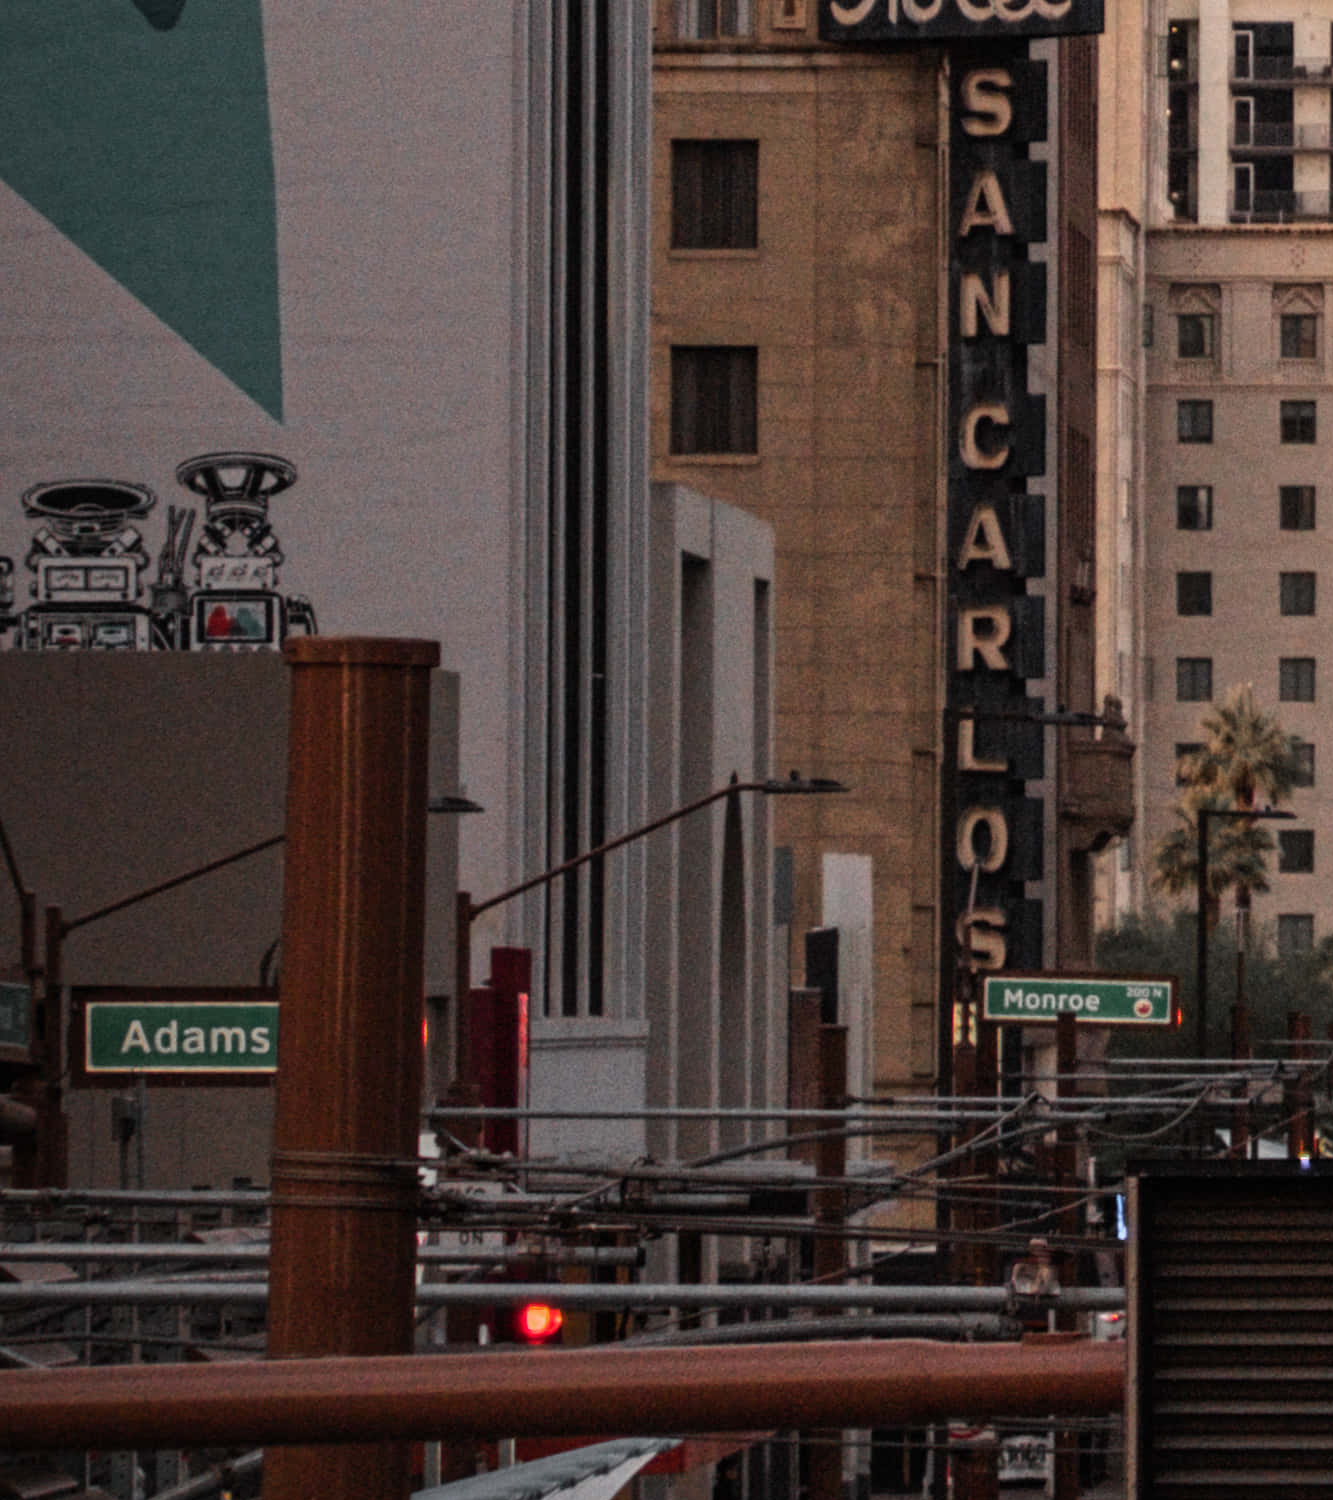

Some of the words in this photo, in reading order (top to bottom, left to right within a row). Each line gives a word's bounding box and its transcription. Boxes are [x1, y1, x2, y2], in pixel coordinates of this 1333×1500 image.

[960, 67, 1015, 337] SAN
[955, 402, 1012, 973] CARLOS
[120, 1019, 271, 1054] Adams
[1003, 988, 1101, 1011] Monroe
[1152, 987, 1163, 998] N
